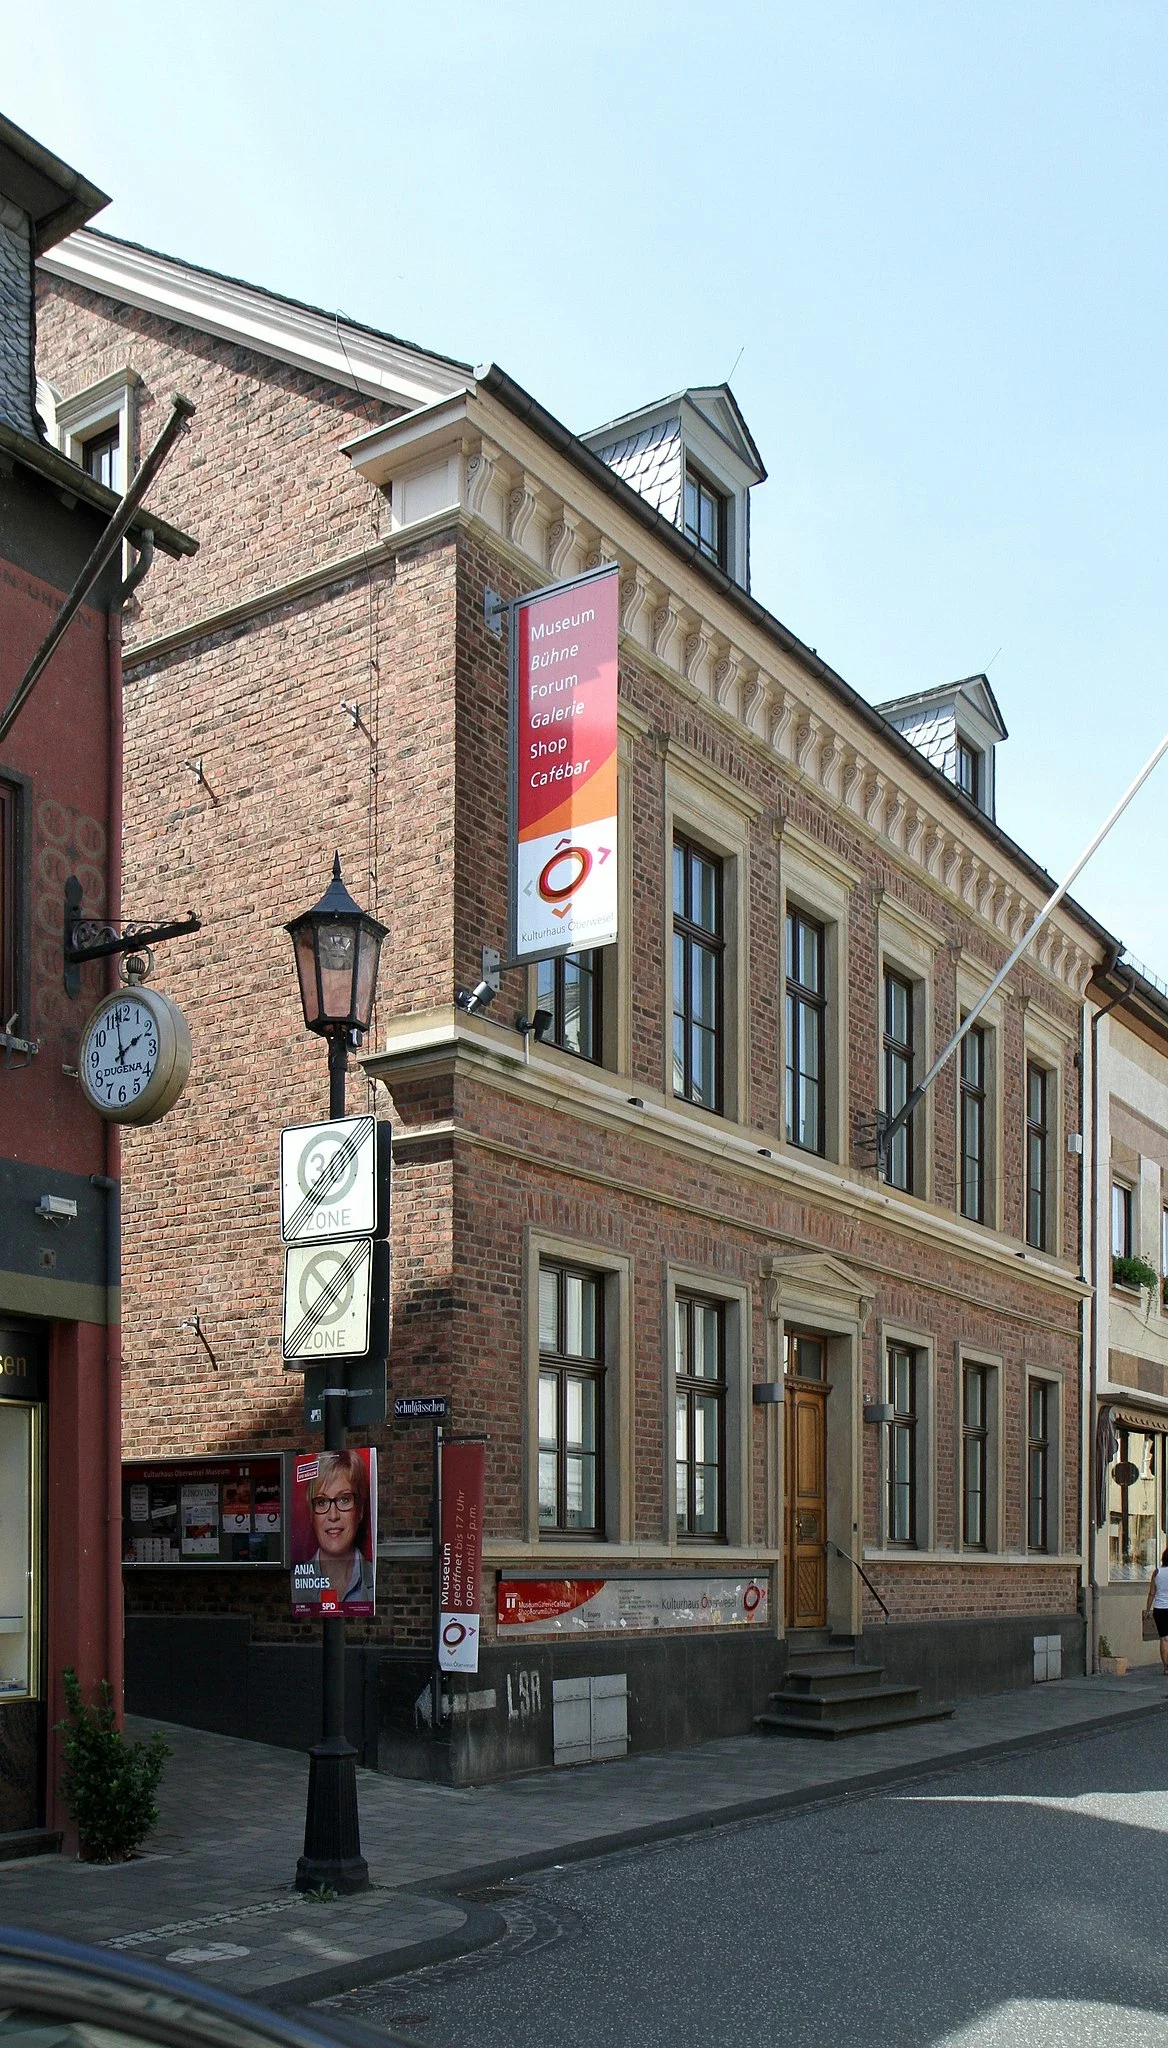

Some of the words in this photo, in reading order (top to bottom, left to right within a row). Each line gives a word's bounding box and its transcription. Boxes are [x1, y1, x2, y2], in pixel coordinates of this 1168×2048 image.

[531, 609, 595, 641] Museum
[531, 644, 579, 671] Bühne
[531, 674, 578, 700] Forum
[531, 700, 585, 729] Galerie
[530, 738, 567, 759] Shop
[530, 759, 591, 788] Cafébar
[521, 924, 566, 943] Kulturhaus
[118, 1004, 130, 1022] 12
[135, 1009, 141, 1024] 1
[105, 1014, 115, 1031] 11
[144, 1020, 152, 1037] 2
[95, 1030, 106, 1048] 10
[148, 1039, 157, 1056] 3
[91, 1051, 100, 1068] 9
[104, 1062, 143, 1077] DUGENA
[142, 1061, 152, 1078] 4
[95, 1070, 103, 1088] 8
[133, 1077, 141, 1095] 5
[106, 1083, 114, 1099] 7
[118, 1085, 126, 1102] 6
[306, 1208, 351, 1231] ZONE
[304, 1329, 346, 1349] ZONE
[395, 1400, 445, 1415] Schulgässchen
[456, 1489, 465, 1512] Uhr
[456, 1515, 464, 1529] 17
[469, 1504, 478, 1531] p.m.
[455, 1533, 463, 1550] bis
[467, 1533, 476, 1542] 5
[467, 1545, 476, 1573] until
[294, 1564, 315, 1575] ANJA
[442, 1543, 451, 1605] Museum
[295, 1577, 330, 1589] BINDGES
[453, 1553, 463, 1607] geöffnet
[466, 1576, 476, 1607] open
[322, 1602, 336, 1610] SPD
[661, 1597, 699, 1610] Kulturhaus
